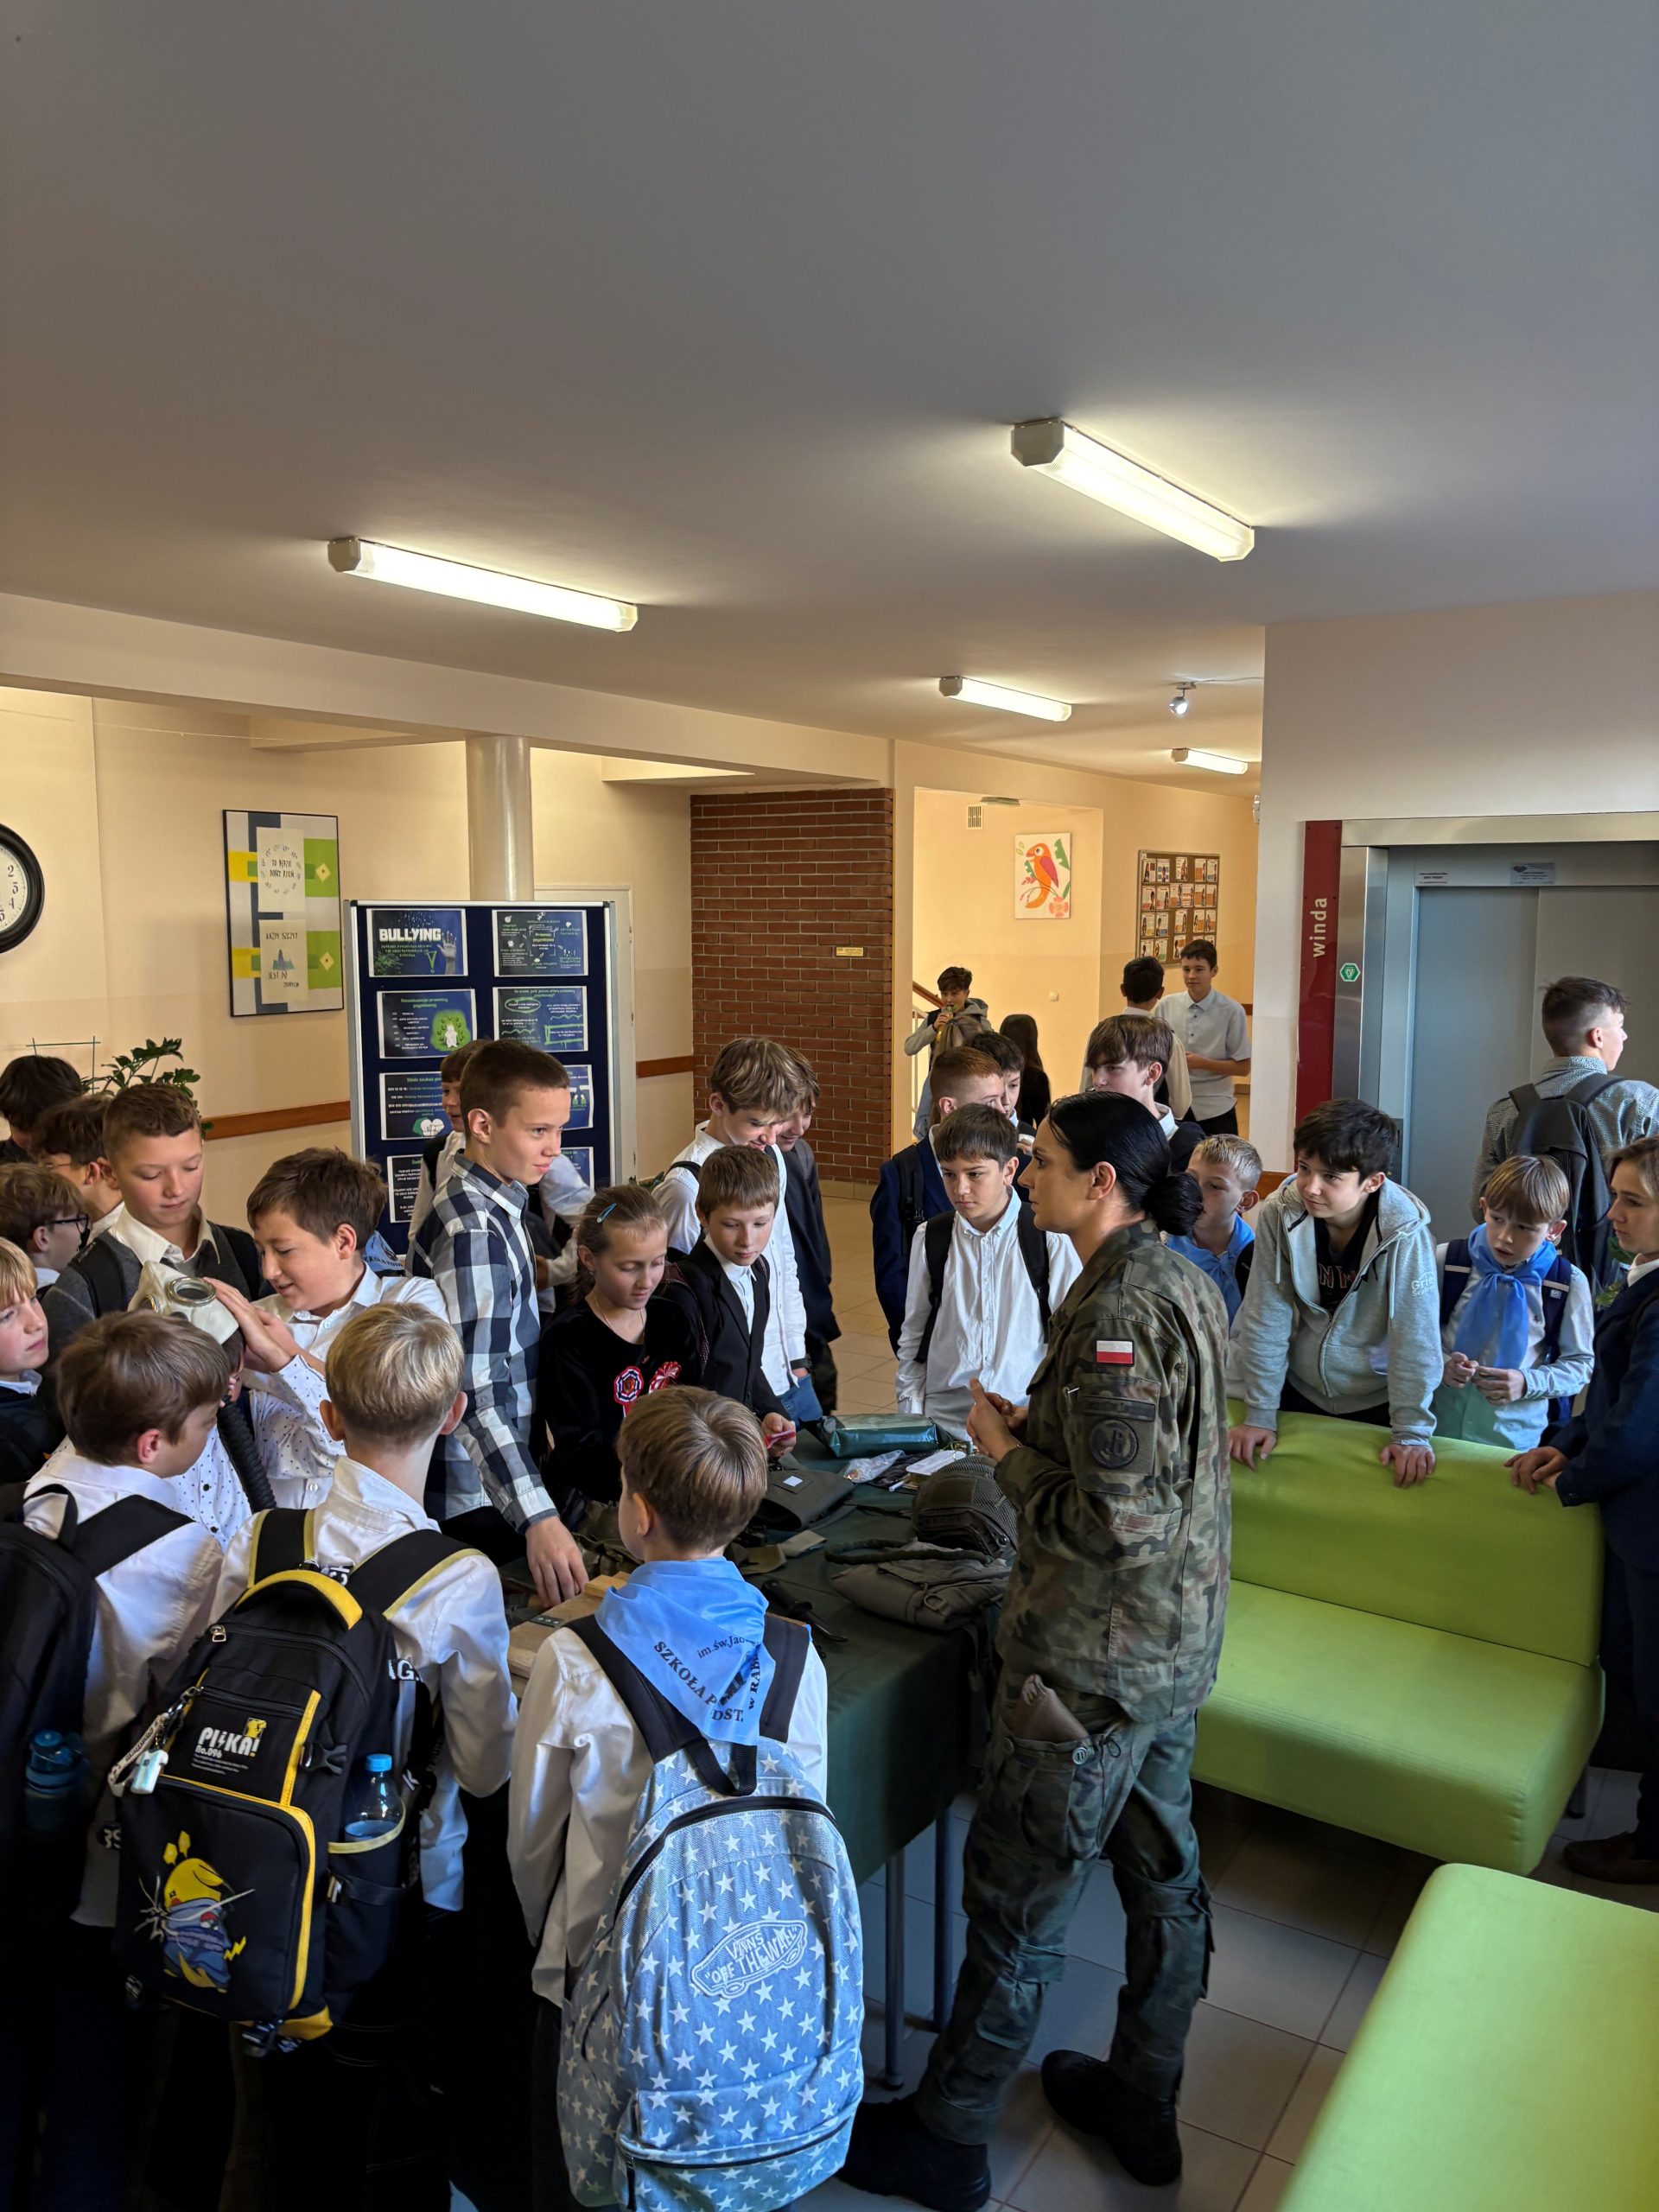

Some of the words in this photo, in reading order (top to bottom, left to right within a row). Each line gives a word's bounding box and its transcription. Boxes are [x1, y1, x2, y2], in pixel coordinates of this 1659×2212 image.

[8, 865, 14, 877] 2
[12, 881, 18, 894] 3
[9, 897, 15, 909] 4
[378, 928, 442, 942] BULLYING
[1309, 898, 1327, 958] winda
[654, 1641, 706, 1700] SZKOŁA
[725, 1932, 764, 1960] VANS
[734, 1947, 766, 1975] THE
